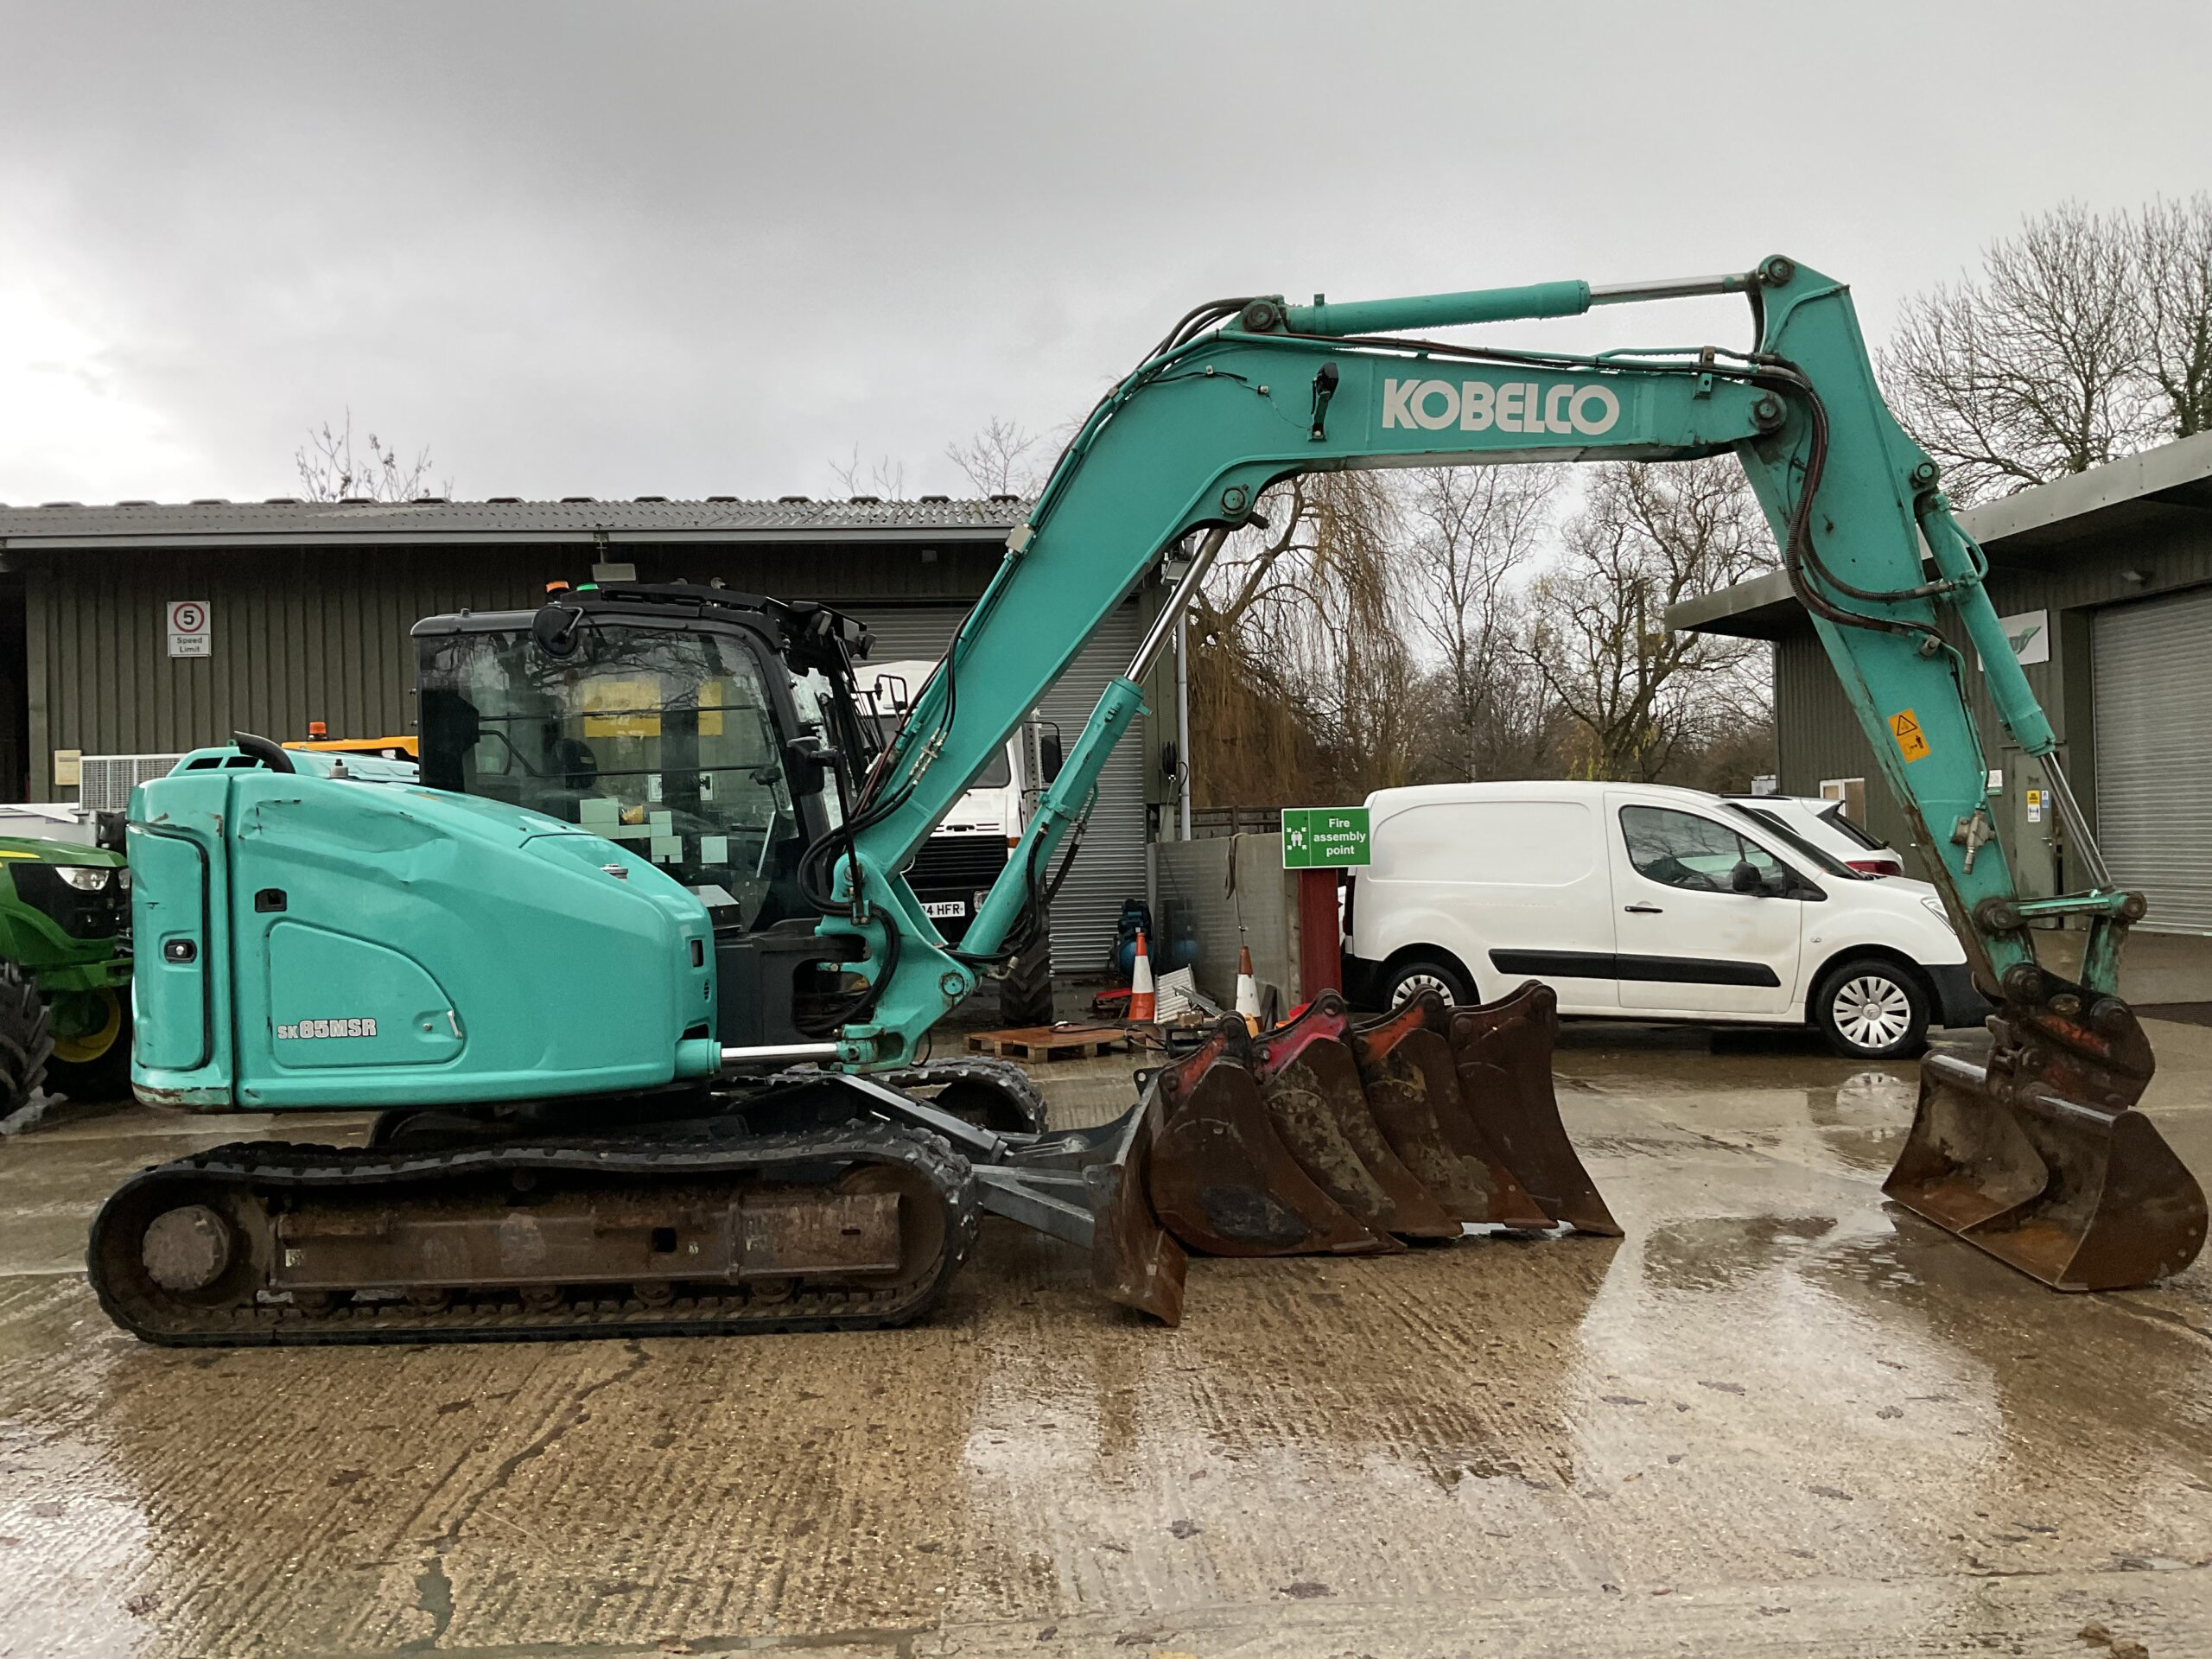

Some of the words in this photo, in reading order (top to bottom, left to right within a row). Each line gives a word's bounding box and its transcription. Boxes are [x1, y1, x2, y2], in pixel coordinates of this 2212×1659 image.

[1382, 378, 1620, 435] KOBELCO
[183, 610, 195, 626] 5
[1328, 817, 1351, 829] Fire
[1313, 830, 1367, 843] assembly
[1325, 845, 1356, 858] point
[937, 903, 960, 916] HFR
[277, 1018, 378, 1039] SK85MSR
